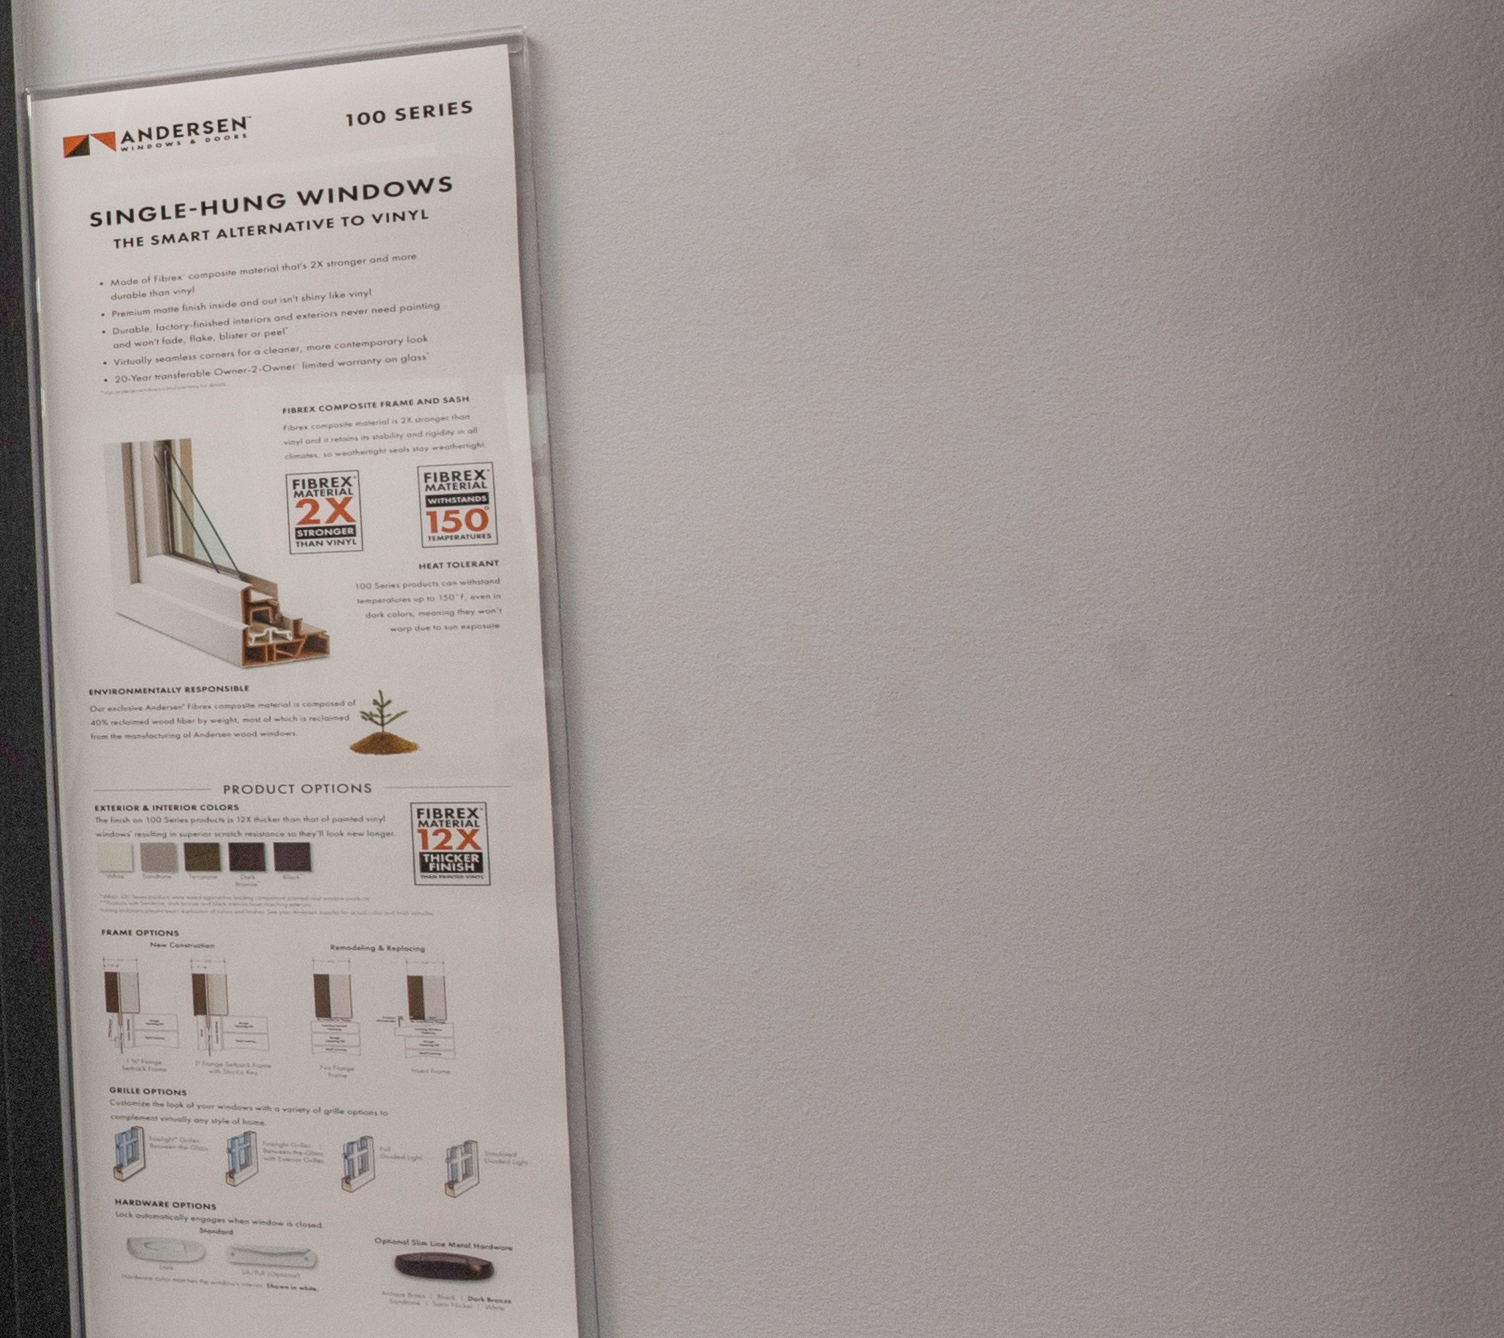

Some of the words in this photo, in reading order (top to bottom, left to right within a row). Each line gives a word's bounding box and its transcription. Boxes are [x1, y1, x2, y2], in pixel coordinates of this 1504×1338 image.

[346, 110, 386, 126] 100
[395, 100, 472, 121] SERIES
[90, 193, 286, 227] SINGLE-HUNG
[297, 176, 452, 206] WINDOWS
[113, 237, 143, 249] THE
[151, 230, 209, 245] SMART
[217, 218, 334, 239] ALTERNATIVE
[341, 215, 364, 227] TO
[372, 209, 429, 224] VINYL
[111, 278, 138, 286] Made
[141, 276, 151, 284] of
[188, 270, 237, 280] composite
[240, 264, 279, 274] material
[282, 263, 307, 271] that's
[327, 259, 366, 267] stronger
[369, 255, 389, 263] and
[111, 291, 147, 300] durable
[150, 289, 170, 297] than
[173, 286, 195, 296] vinyl
[182, 303, 206, 311] finish
[209, 300, 237, 309] inside
[240, 298, 259, 307] and
[280, 295, 298, 303] isn't
[301, 294, 326, 302] shiny
[329, 291, 345, 299] like
[349, 288, 371, 298] vinyl
[113, 325, 152, 335] Durable,
[233, 317, 271, 325] interiors
[274, 313, 293, 322] and
[296, 312, 338, 320] exteriors
[371, 304, 396, 313] need
[399, 303, 440, 313] painting
[113, 340, 131, 349] and
[134, 339, 159, 347] won't
[190, 334, 215, 342] flake,
[219, 332, 247, 340] blister
[114, 356, 152, 366] Virtually
[155, 353, 197, 363] seamless
[334, 339, 403, 349] contemporary
[407, 335, 428, 343] look
[115, 375, 151, 383] 20-Year
[155, 369, 211, 380] transferable
[302, 359, 334, 369] limited
[337, 358, 381, 366] warranty
[283, 406, 315, 414] FIBREX
[319, 402, 376, 412] COMPOSITE
[380, 399, 413, 407] FRAME
[293, 476, 352, 490] FIBREX
[424, 469, 486, 483] FIBREX
[294, 486, 353, 498] MATERIAL
[425, 481, 487, 492] MATERIAL
[428, 495, 486, 505] WITHSTANDS
[296, 497, 354, 525] 2X
[297, 527, 354, 537] STRONGER
[428, 533, 492, 541] TEMPERATURES
[447, 560, 499, 568] TOLERANT
[89, 687, 181, 695] ENVIRONMENTALLY
[185, 685, 248, 693] RESPONSIBLE
[224, 784, 295, 794] PRODUCT
[301, 783, 372, 794] OPTIONS
[417, 808, 479, 819] FIBREX
[418, 828, 480, 850] 12X
[423, 854, 479, 862] THICKER
[429, 863, 474, 871] FINISH
[143, 1088, 187, 1096] OPTIONS
[115, 1199, 169, 1207] HARDWARE
[172, 1202, 216, 1210] OPTIONS
